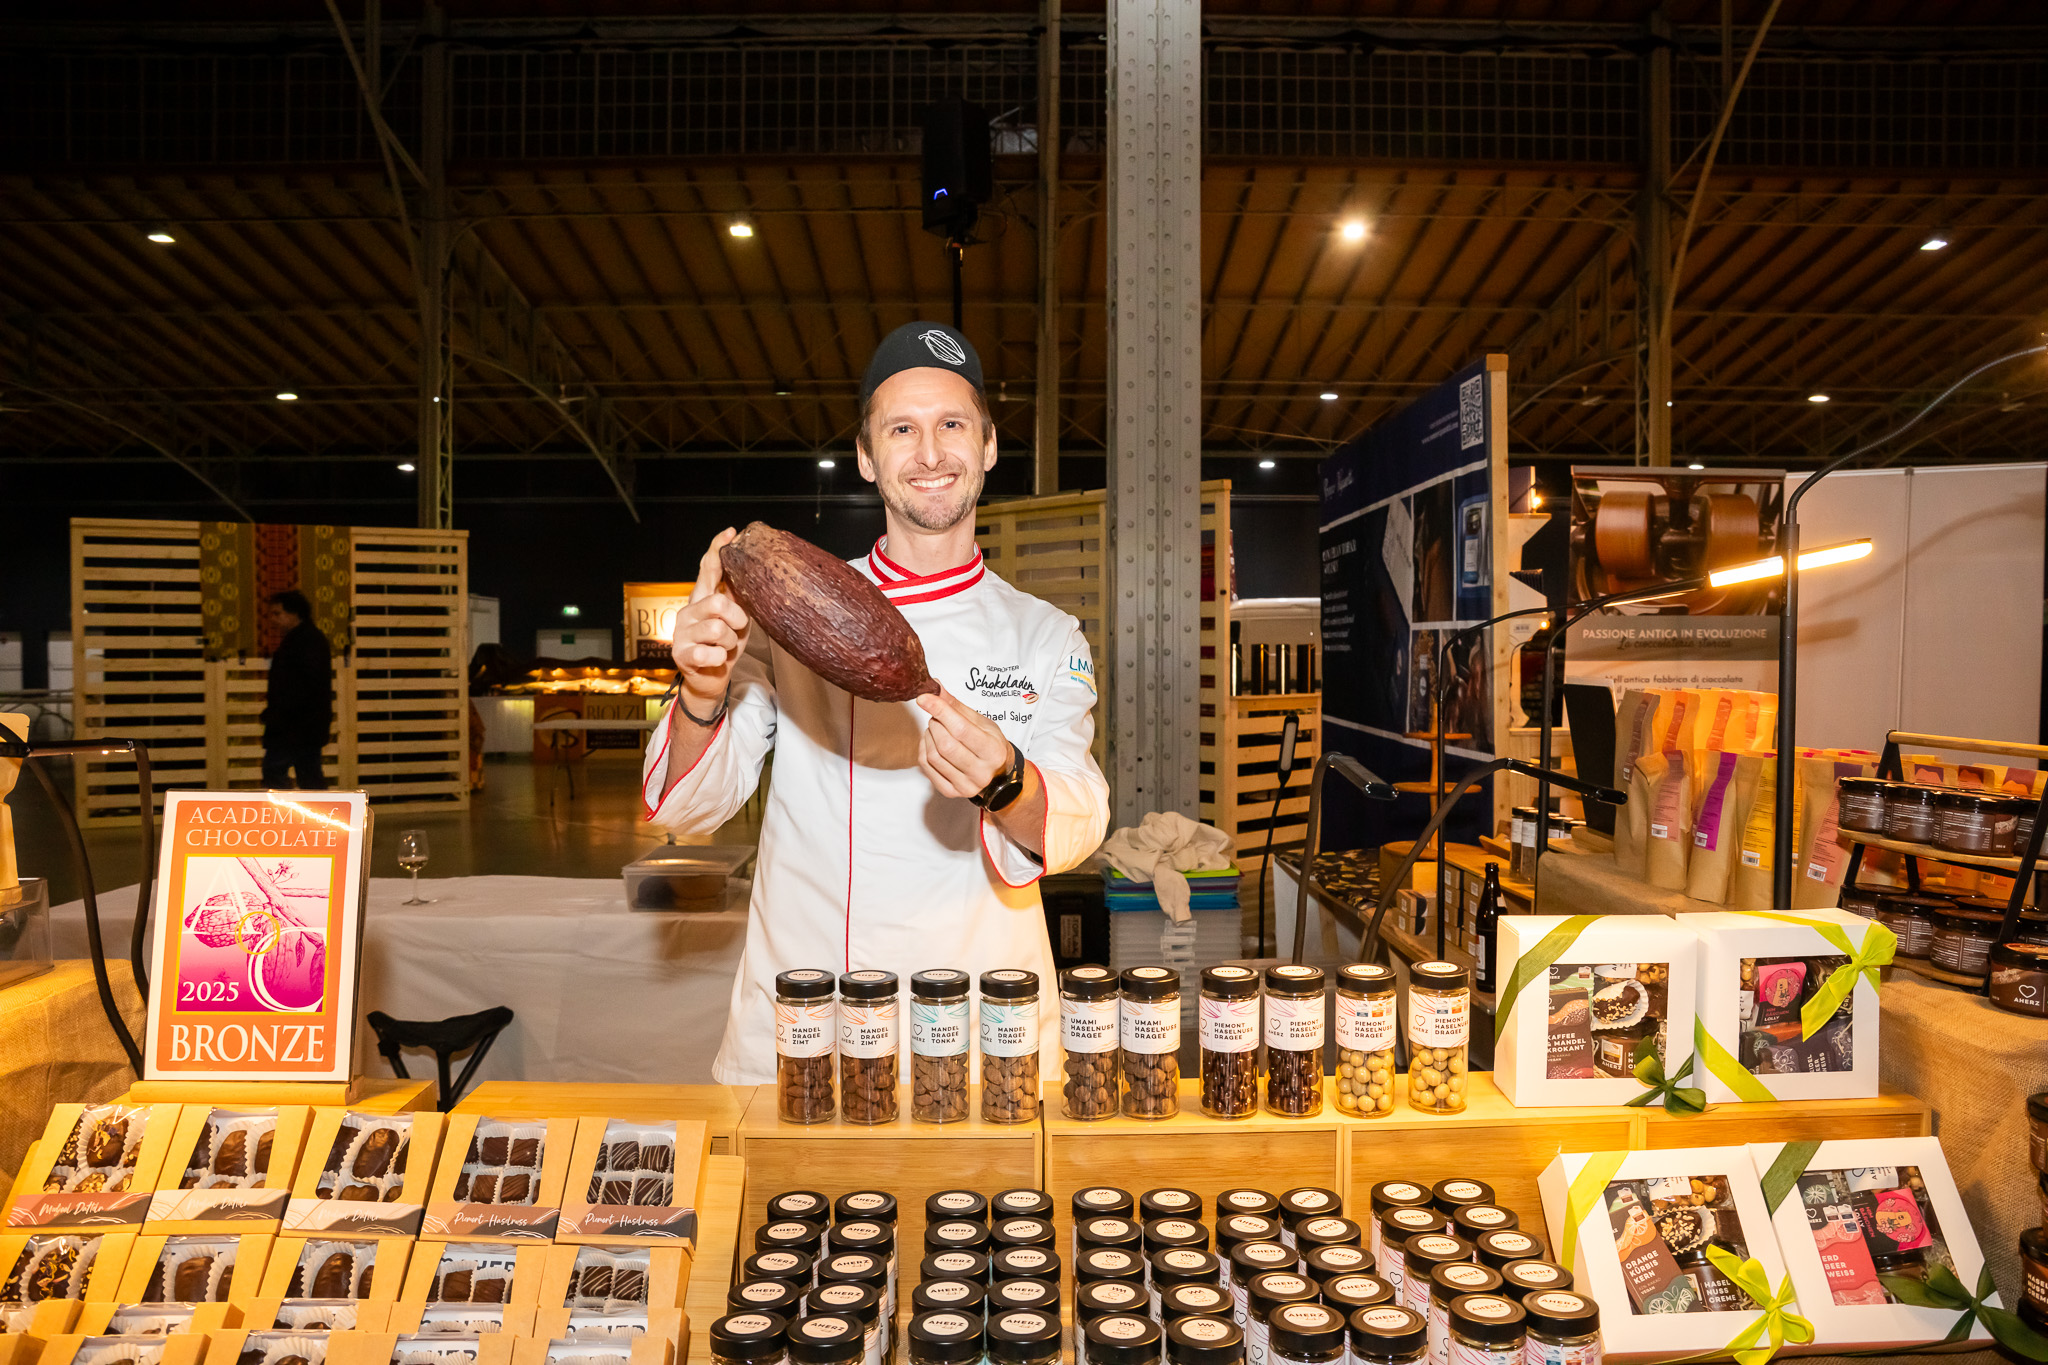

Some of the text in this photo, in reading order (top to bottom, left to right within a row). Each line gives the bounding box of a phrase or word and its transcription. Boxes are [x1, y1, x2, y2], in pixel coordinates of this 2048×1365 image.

[1583, 629, 1767, 639] PASSIONE ANTICA IN EVOLUZIONE
[965, 667, 1034, 690] Schokoladen
[1653, 675, 1688, 683] fabbrica
[1691, 675, 1699, 683] di
[1702, 675, 1743, 683] cioccolato
[189, 807, 313, 824] ACADEMY
[185, 829, 337, 847] CHOCOLATE
[181, 981, 240, 1002] 2025
[2014, 997, 2040, 1006] AHERZ
[1071, 1023, 1114, 1032] HASELNUSS
[1135, 1024, 1177, 1032] HASELNUSS
[1547, 1033, 1575, 1041] KAFFEE
[169, 1024, 325, 1062] BRONZE
[1547, 1045, 1585, 1053] KROKANT
[1602, 1061, 1622, 1070] AHERZ
[1389, 1186, 1413, 1196] AHERZ
[786, 1197, 813, 1206] AHERZ
[1298, 1192, 1319, 1205] AHERZ
[1008, 1224, 1037, 1232] AHERZ
[1237, 1219, 1265, 1229] AHERZ
[1314, 1221, 1338, 1233] AHERZ
[1328, 1252, 1361, 1260] AHERZ
[1626, 1250, 1659, 1270] ORANGE
[1822, 1254, 1839, 1262] ERD
[1629, 1260, 1659, 1277] KÜRBIS
[1825, 1262, 1847, 1270] BEER
[1452, 1270, 1480, 1280] AHERZ
[1633, 1270, 1656, 1284] KERN
[1827, 1269, 1855, 1278] WEISS
[1704, 1279, 1731, 1288] HASEL
[2027, 1279, 2045, 1295] NUSS
[1641, 1286, 1656, 1295] VEGAN
[1706, 1288, 1729, 1296] NUSS
[1540, 1298, 1579, 1306] AHERZ
[1709, 1295, 1736, 1304] CREME
[1472, 1303, 1504, 1311] AHERZ
[1368, 1313, 1402, 1321] AHERZ
[811, 1322, 845, 1331] AHERZ
